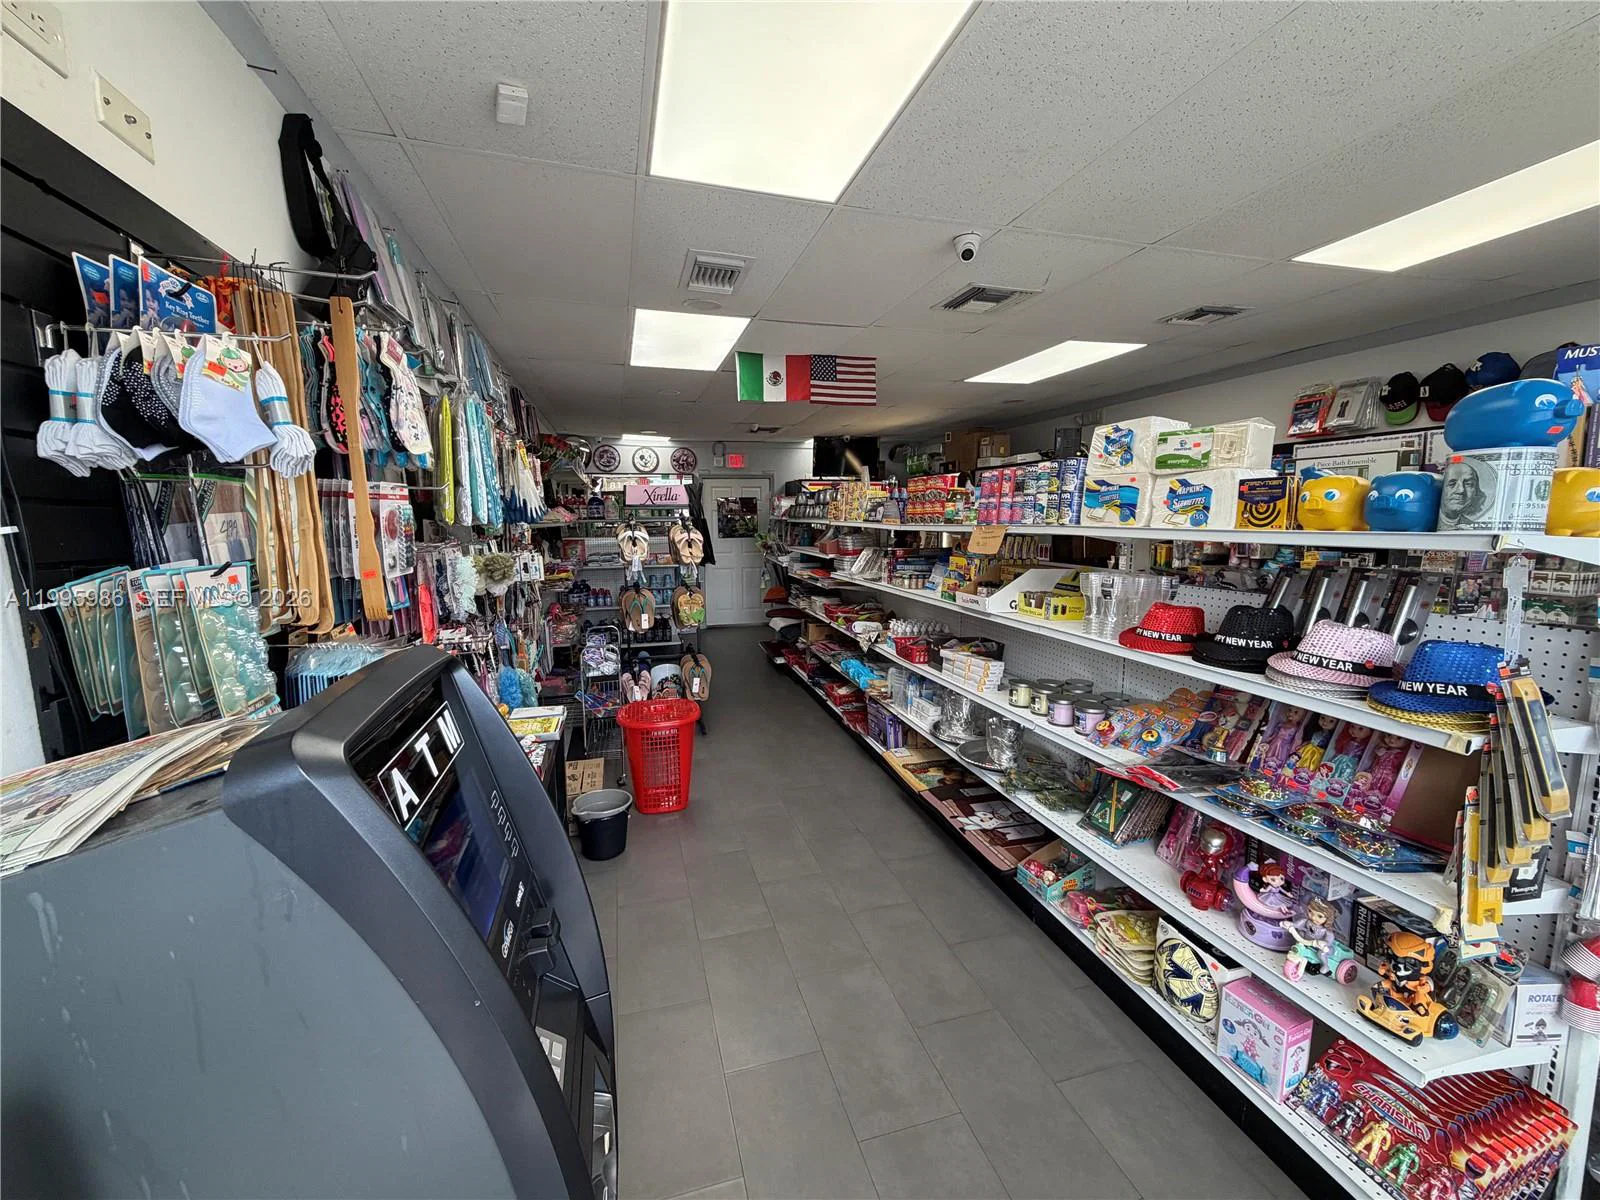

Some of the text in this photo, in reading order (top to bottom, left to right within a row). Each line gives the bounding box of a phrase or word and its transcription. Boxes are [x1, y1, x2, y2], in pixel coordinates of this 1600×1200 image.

[1142, 629, 1160, 639] NEW
[1161, 633, 1183, 642] YEAR
[1225, 636, 1246, 647] NEW
[1247, 639, 1274, 649] YEAR
[1296, 652, 1317, 665] NEW
[1320, 658, 1354, 672] YEAR
[1400, 682, 1424, 693] NEW
[1425, 682, 1469, 697] YEAR
[388, 709, 461, 821] ATM
[1510, 884, 1539, 894] Photograph
[1354, 905, 1370, 955] RHUBARB
